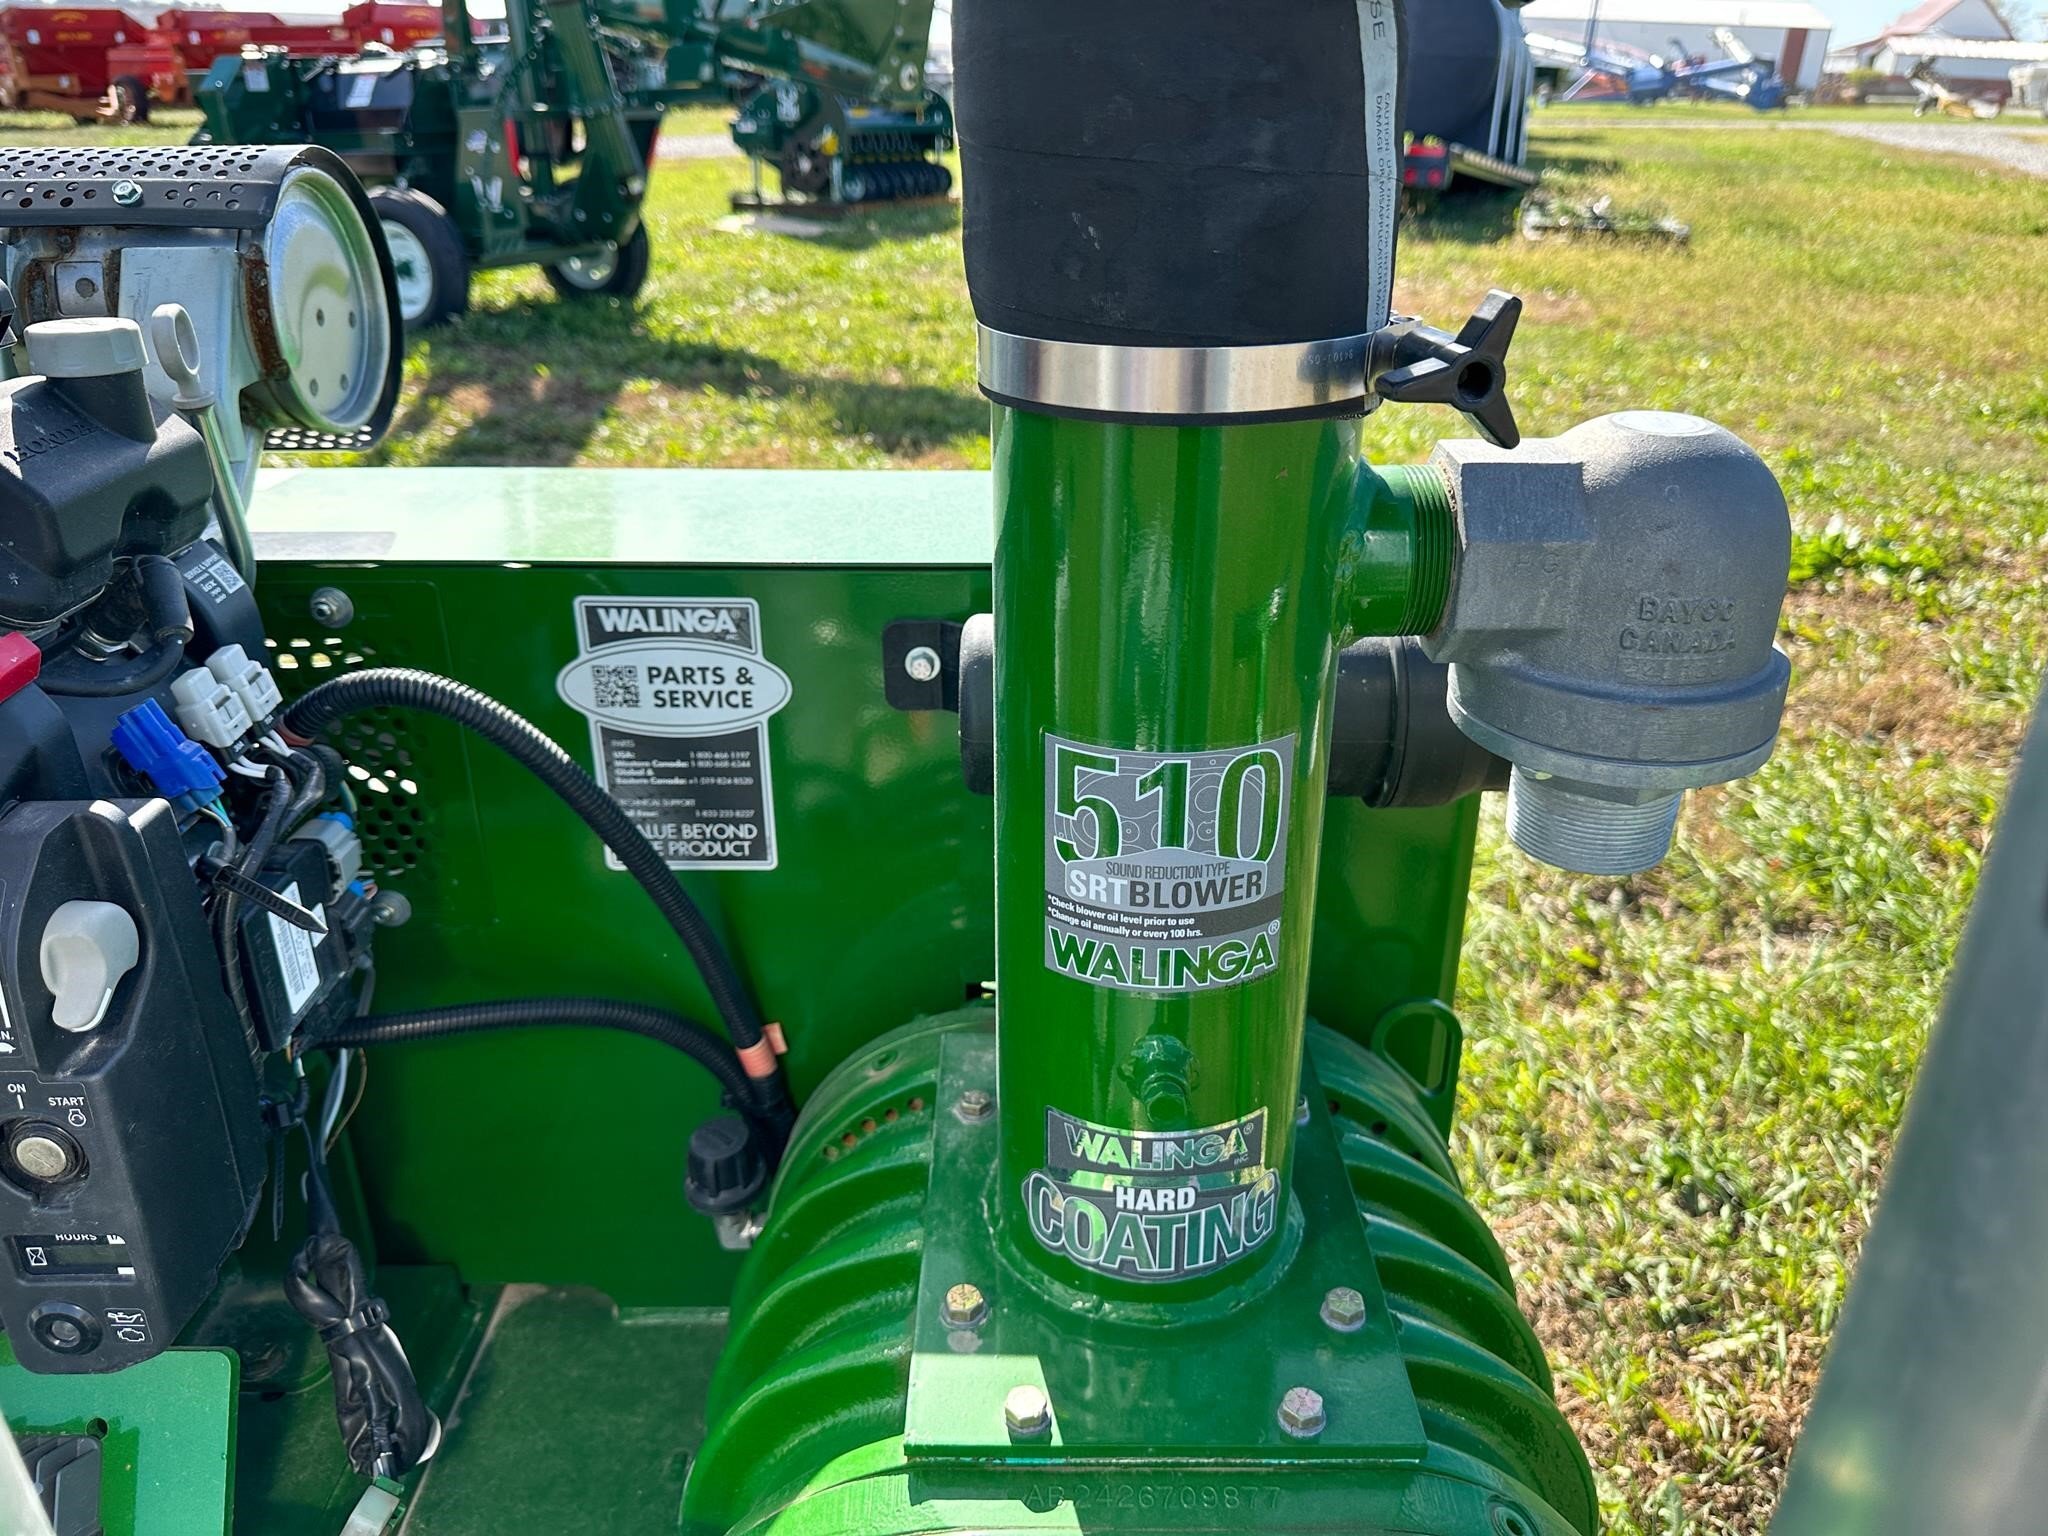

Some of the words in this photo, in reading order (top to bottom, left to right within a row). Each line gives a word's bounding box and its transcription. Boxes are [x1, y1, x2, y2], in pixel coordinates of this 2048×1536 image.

[1375, 95, 1383, 152] DAMAGE
[647, 667, 724, 685] PARTS
[736, 667, 754, 685] &
[654, 691, 754, 708] SERVICE
[1054, 743, 1284, 865] 510
[636, 824, 677, 839] LUE
[681, 824, 758, 839] BEYOND
[669, 841, 752, 856] PRODUCT
[1105, 861, 1142, 879] SOUND
[1144, 864, 1203, 880] REDUCTION
[1205, 861, 1230, 878] TYPE
[1075, 906, 1105, 920] blower
[1107, 911, 1119, 922] oil
[1120, 913, 1142, 926] level
[1144, 916, 1166, 928] prior
[1167, 916, 1177, 925] to
[1179, 917, 1195, 925] use
[1081, 918, 1091, 928] oil
[1093, 921, 1130, 937] annually
[1132, 928, 1142, 937] or
[1143, 926, 1168, 940] every
[1170, 928, 1185, 938] 100
[1186, 928, 1203, 937] hrs.
[7, 1083, 26, 1093] ON
[48, 1096, 85, 1107] START
[1116, 1186, 1196, 1211] HARD
[1028, 1171, 1277, 1272] COATING
